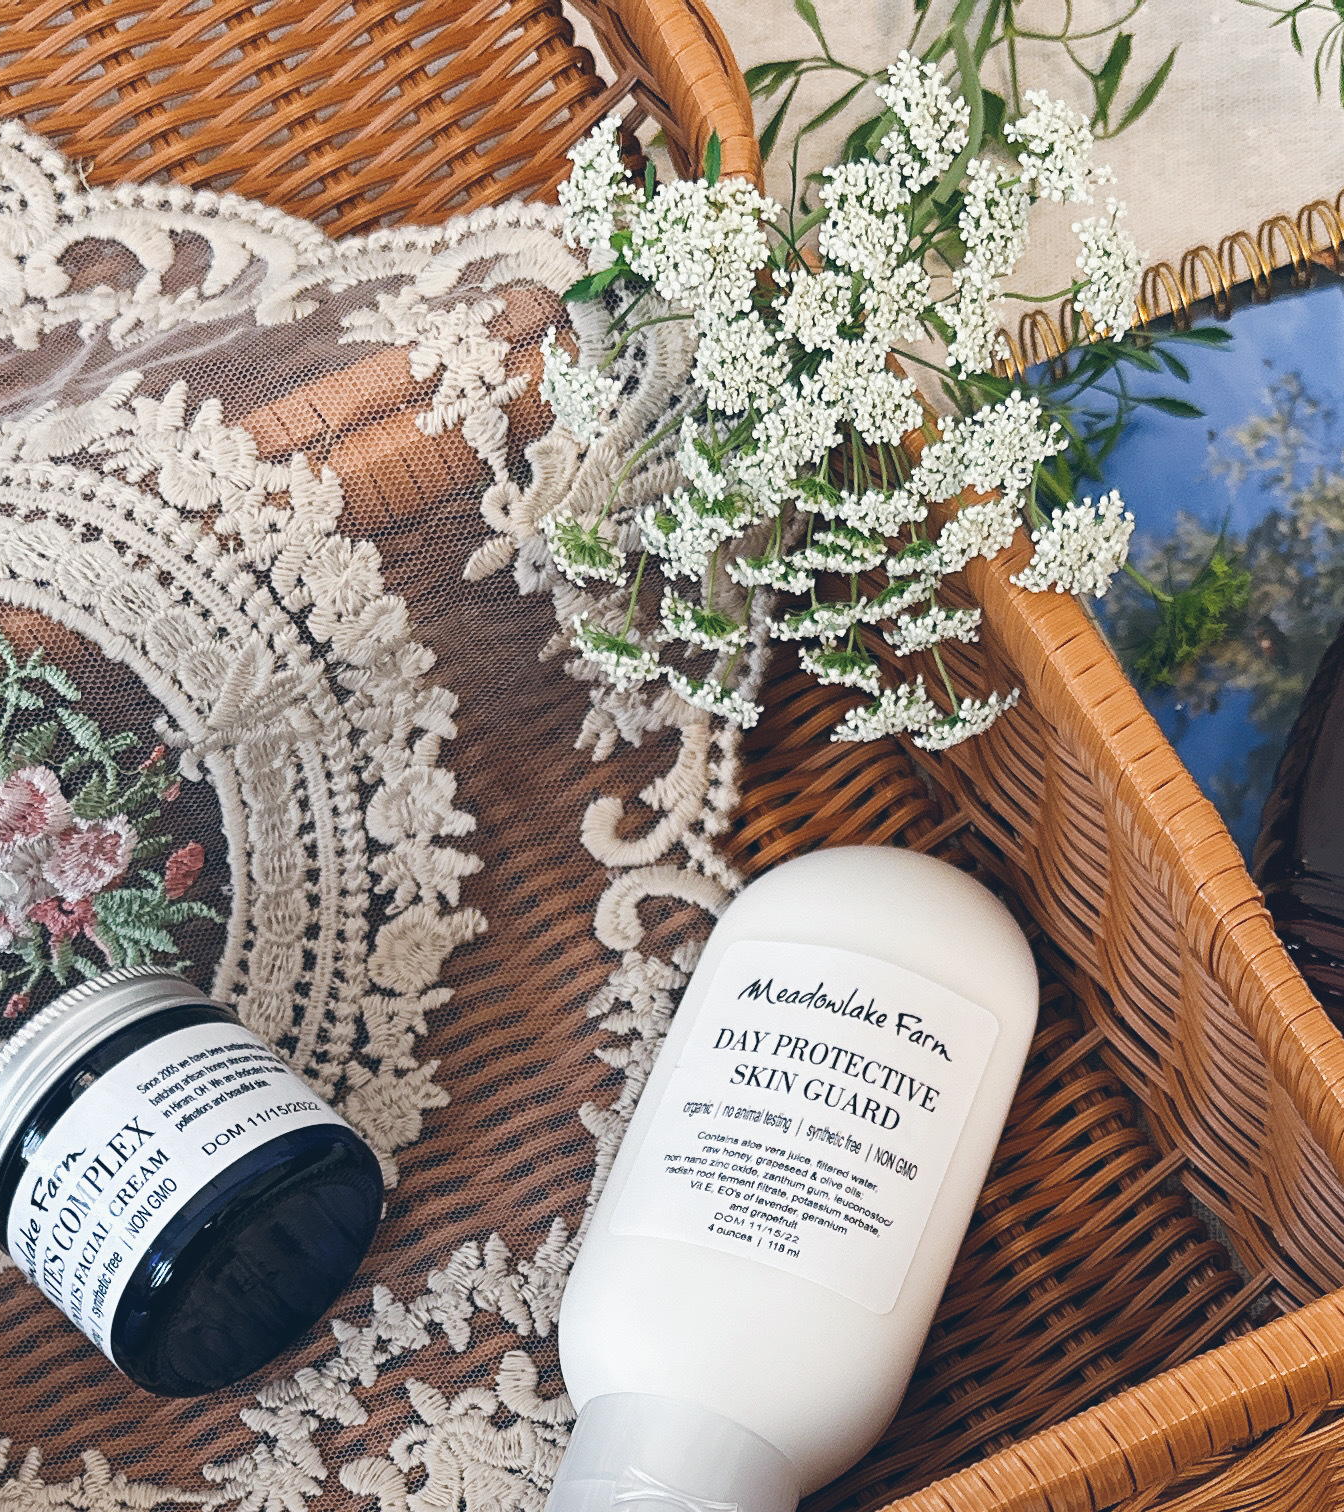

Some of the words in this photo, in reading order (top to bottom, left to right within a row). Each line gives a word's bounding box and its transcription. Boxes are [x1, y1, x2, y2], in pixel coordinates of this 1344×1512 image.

[736, 977, 888, 1029] Meadowlake
[894, 1011, 953, 1063] Farm
[135, 1076, 162, 1095] Since
[158, 1063, 180, 1081] 2005
[178, 1058, 192, 1070] we
[186, 1051, 210, 1064] have
[147, 1081, 186, 1107] batching
[180, 1068, 208, 1087] artisan
[161, 1108, 174, 1119] in
[206, 1075, 226, 1089] We
[712, 1027, 771, 1053] DAY
[771, 1033, 941, 1113] PROTECTIVE
[729, 1063, 800, 1094] SKIN
[803, 1078, 901, 1131] GUARD
[174, 1102, 214, 1133] pollinators
[210, 1092, 228, 1107] and
[200, 1122, 247, 1156] DOM
[246, 1100, 322, 1127] 11/15/2022
[663, 1153, 682, 1162] non
[683, 1155, 708, 1166] nano
[708, 1158, 731, 1170] zinc
[682, 1101, 714, 1117] organic
[721, 1104, 735, 1118] no
[733, 1106, 766, 1123] animal
[762, 1110, 793, 1135] testing
[805, 1123, 845, 1149] synthetic
[843, 1134, 862, 1155] free
[873, 1146, 897, 1170] NON
[894, 1157, 918, 1181] GMO
[696, 1130, 740, 1145] Contains
[740, 1139, 763, 1151] aloe
[764, 1145, 787, 1157] vera
[815, 1159, 850, 1179] filtered
[701, 1145, 721, 1155] raw
[754, 1155, 809, 1178] grapeseed
[809, 1170, 818, 1182] &
[819, 1176, 844, 1191] olive
[29, 1147, 87, 1213] Farm
[51, 1115, 156, 1251] COMPLEX
[665, 1165, 695, 1176] radish
[695, 1169, 716, 1179] root
[717, 1171, 756, 1189] ferment
[790, 1193, 842, 1219] potassium
[73, 1221, 109, 1287] FACIAL
[109, 1147, 171, 1217] CREAM
[690, 1179, 704, 1191] Vit
[716, 1184, 742, 1199] EO's
[742, 1192, 756, 1202] of
[800, 1211, 848, 1236] geranium
[713, 1211, 746, 1227] DOM
[749, 1221, 800, 1245] 11/15/22
[728, 1202, 750, 1214] and
[749, 1208, 799, 1230] grapefruit
[91, 1272, 112, 1319] synthetic
[102, 1251, 123, 1275] free
[127, 1204, 153, 1234] NON
[146, 1177, 178, 1210] GMO
[707, 1223, 715, 1232] 4
[715, 1226, 753, 1243] ounces
[768, 1240, 786, 1253] 118
[785, 1247, 801, 1259] ml
